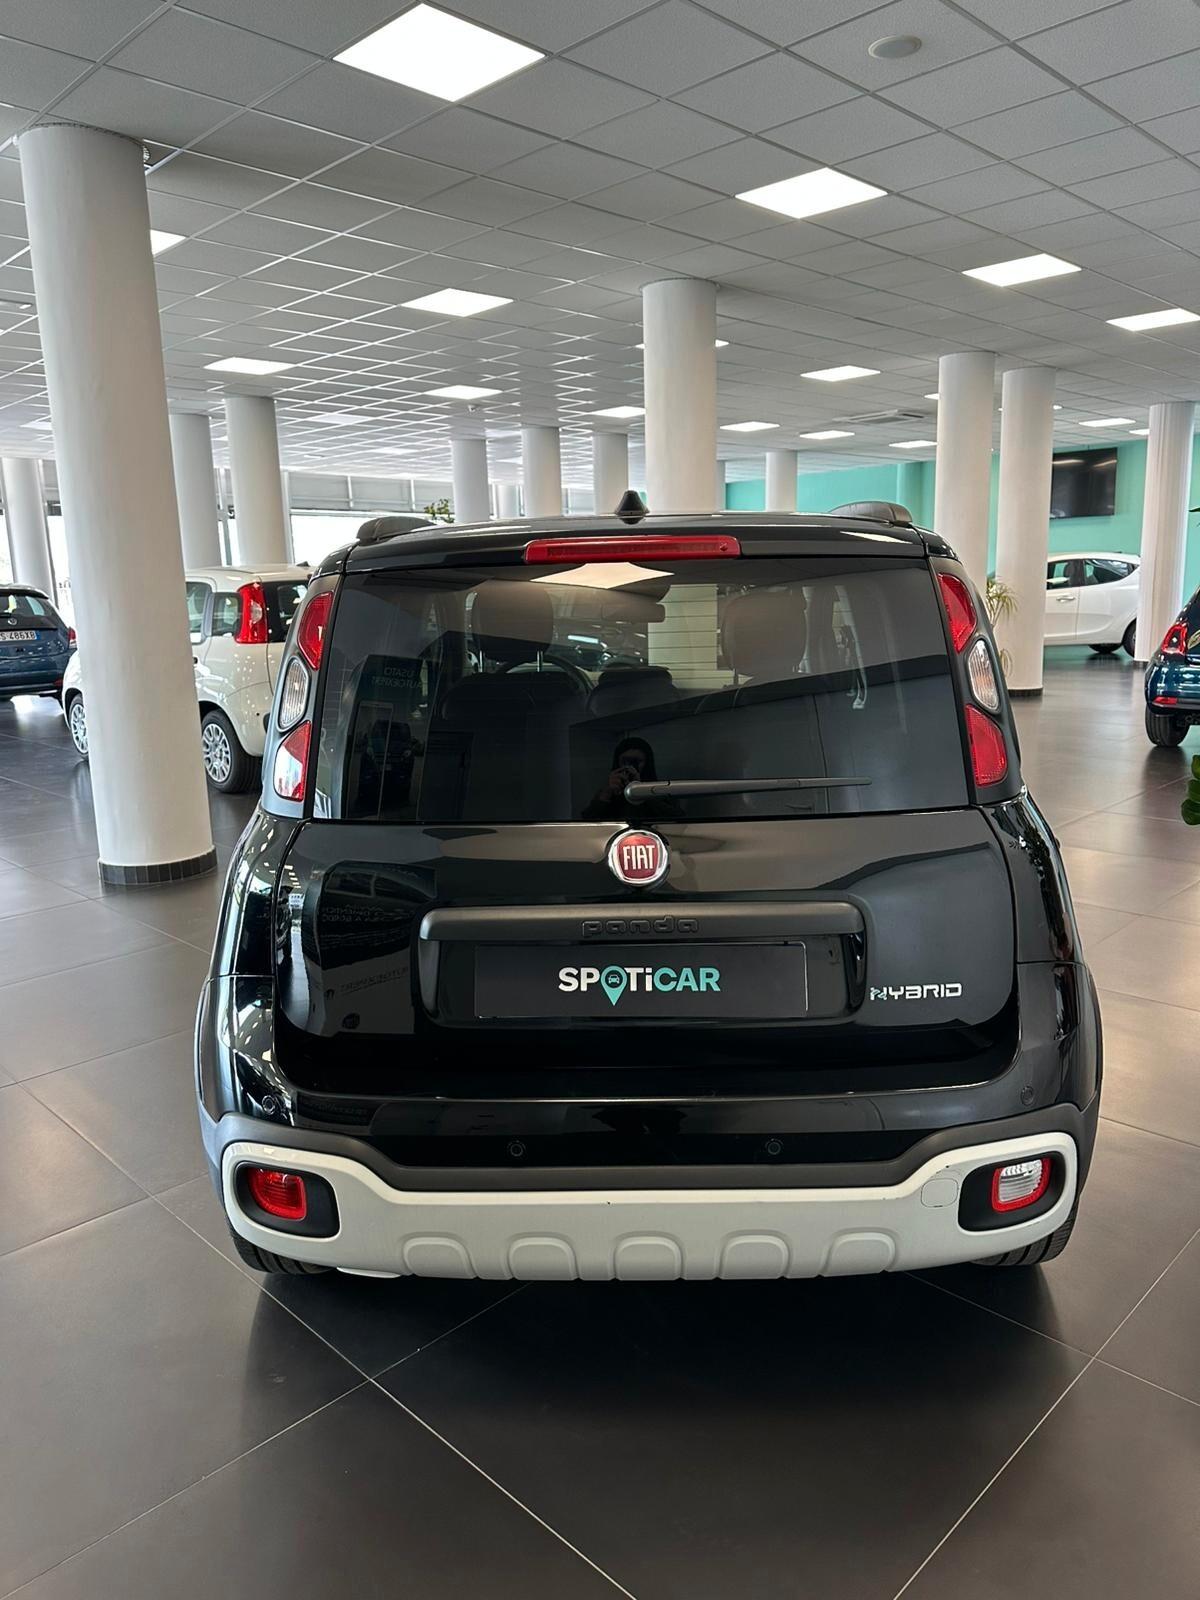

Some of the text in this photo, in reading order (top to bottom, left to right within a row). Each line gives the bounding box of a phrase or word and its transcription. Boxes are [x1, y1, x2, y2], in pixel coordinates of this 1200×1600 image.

[622, 844, 655, 871] FIAT
[582, 914, 699, 937] panda
[870, 982, 962, 1000] HYBRID
